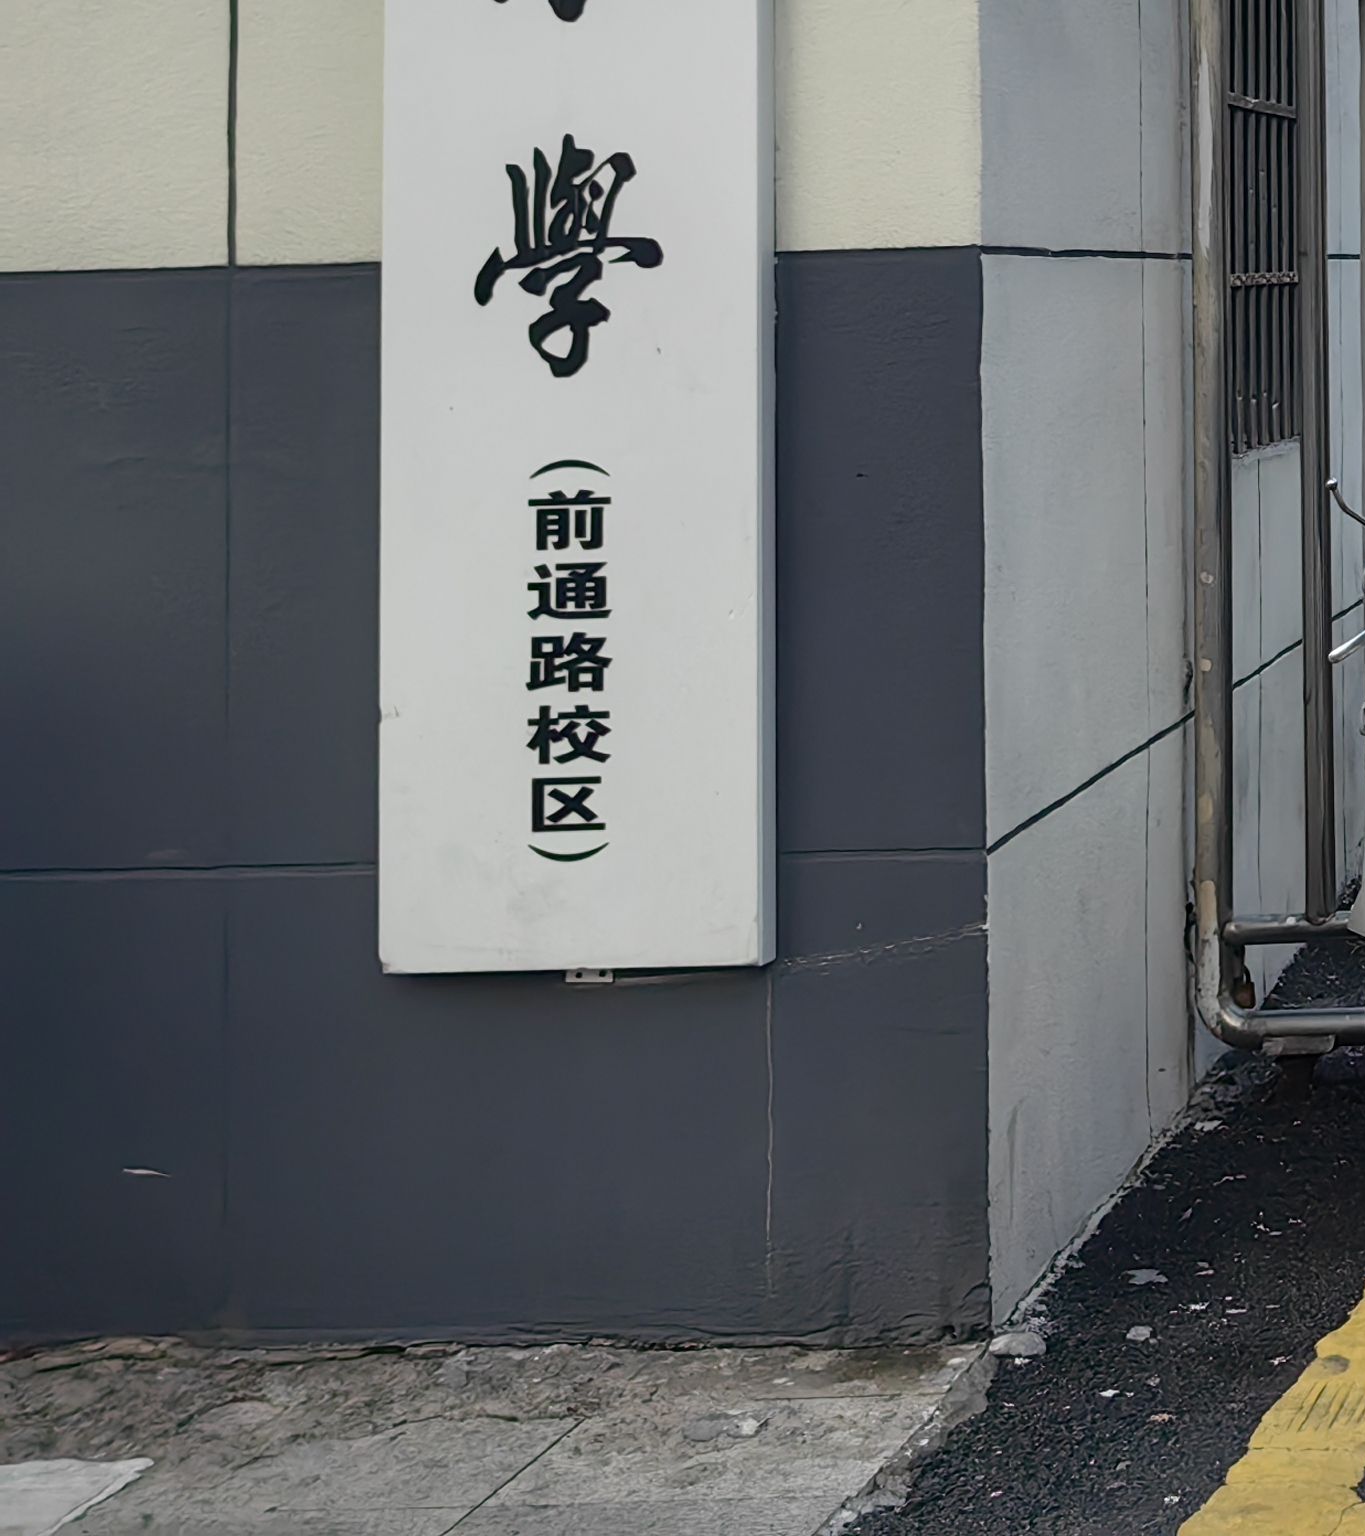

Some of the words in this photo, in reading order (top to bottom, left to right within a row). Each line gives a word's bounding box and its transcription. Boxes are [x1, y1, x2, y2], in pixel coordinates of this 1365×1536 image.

[526, 459, 612, 862] （前通路校区）
